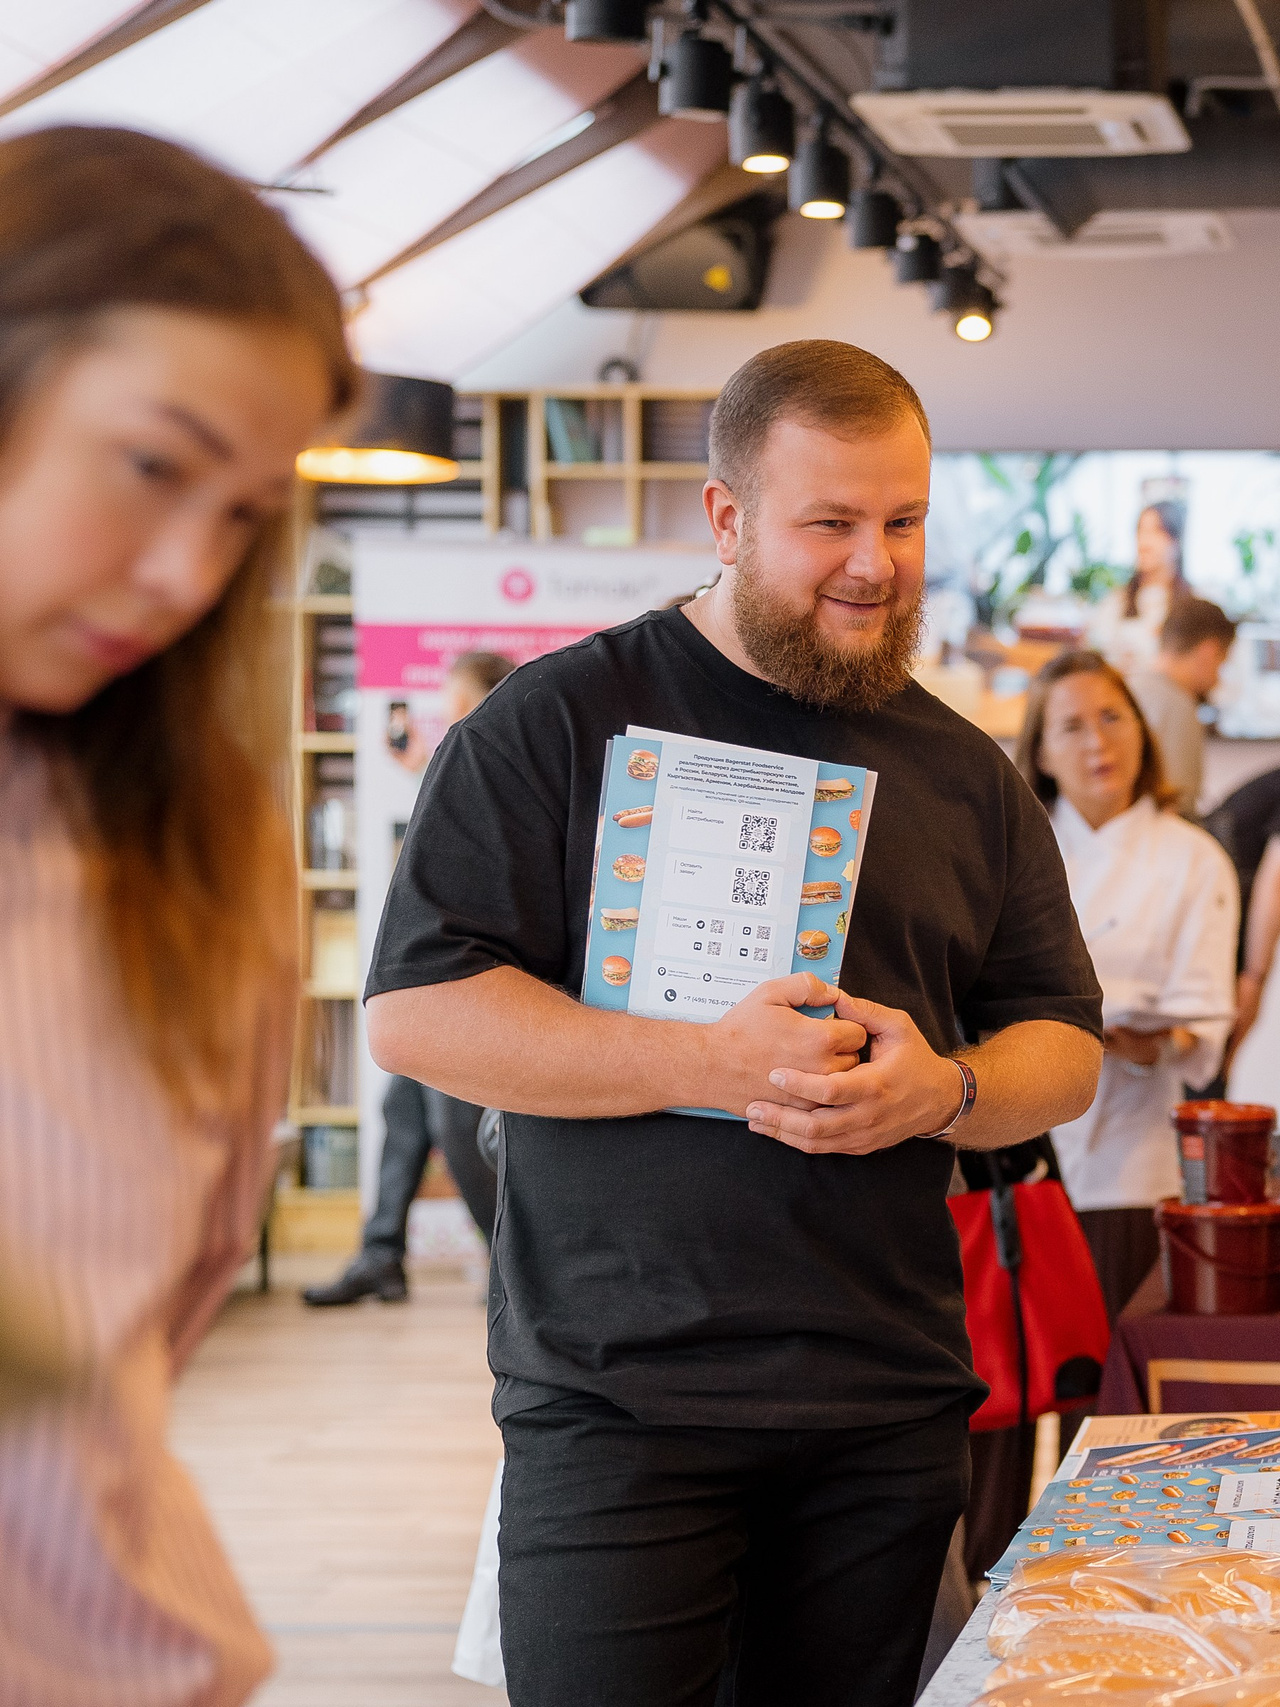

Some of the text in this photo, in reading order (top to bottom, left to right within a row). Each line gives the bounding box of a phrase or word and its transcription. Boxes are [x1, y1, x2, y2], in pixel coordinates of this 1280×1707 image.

[679, 760, 712, 768] реализуется
[730, 767, 784, 778] дистрибьюторскую
[694, 754, 784, 770] Продукция Bagerstat Foodservice
[667, 773, 704, 782] Кыргызстане,
[706, 778, 732, 786] Армении,
[733, 782, 774, 791] Азербайджане
[701, 770, 728, 778] Беларуси,
[729, 774, 761, 783] Казахстане,
[763, 778, 799, 787] Узбекистане,
[686, 816, 724, 824] дистрибьютора
